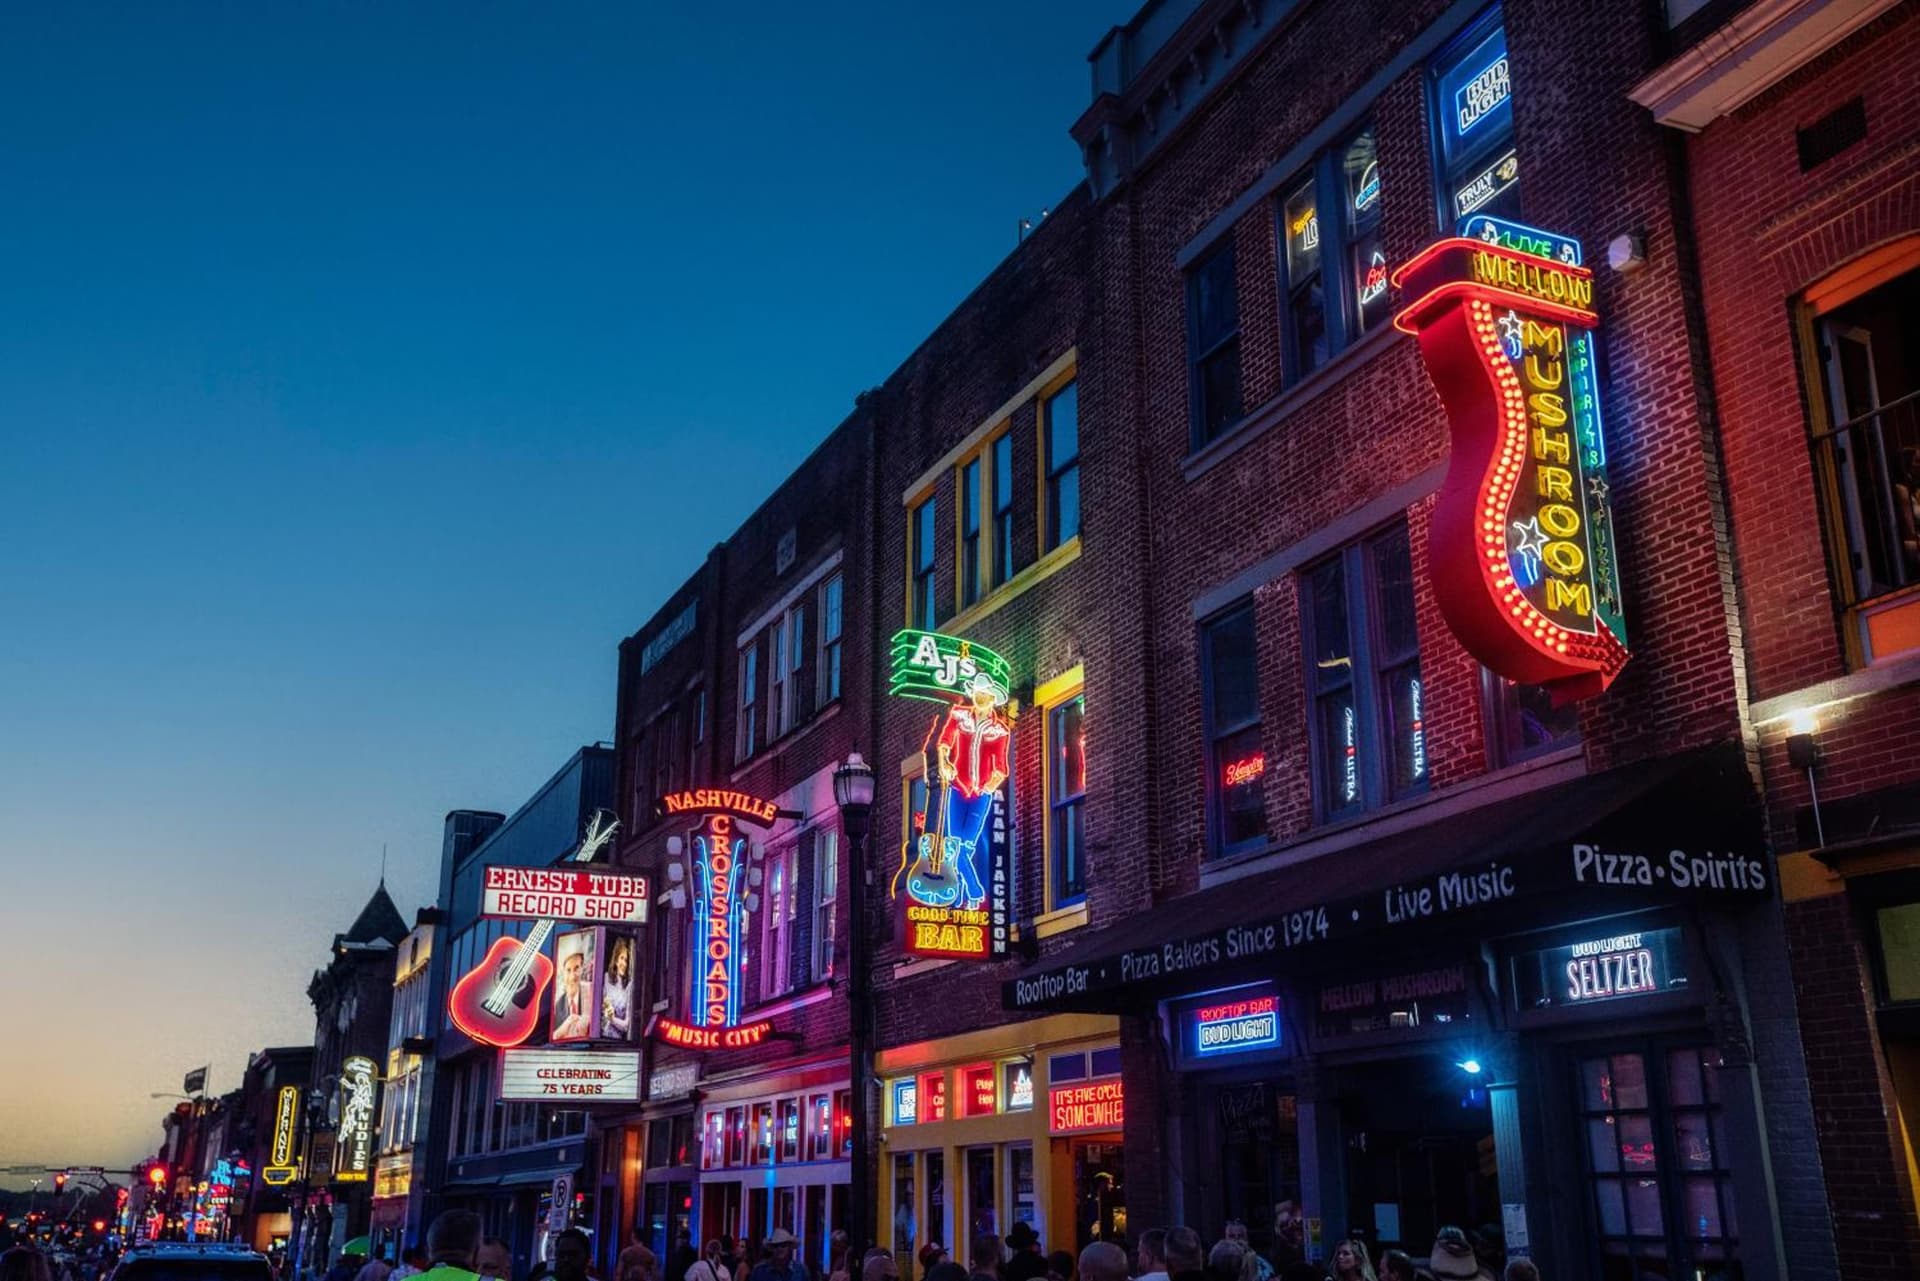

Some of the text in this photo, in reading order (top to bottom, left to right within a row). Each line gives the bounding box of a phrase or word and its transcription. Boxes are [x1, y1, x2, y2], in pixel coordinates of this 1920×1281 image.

[1466, 59, 1509, 104] BUD
[1459, 172, 1492, 205] TRULY
[1500, 231, 1552, 257] LIVE
[1476, 251, 1592, 305] MELLOW
[1575, 338, 1599, 466] SPIRITS
[1522, 320, 1593, 616] MUSHROOM
[1414, 731, 1424, 777] ULTRA
[1347, 756, 1356, 800] ULTRA
[664, 789, 777, 820] NASHVILLE
[487, 867, 646, 897] ERNEST TUBB
[993, 790, 1006, 953] ALAN JACKSON
[1573, 844, 1766, 890] Pizza Spirits
[498, 893, 635, 919] RECORD SHOP
[706, 815, 731, 1025] CROSSROADS
[915, 922, 984, 952] BAR
[1016, 862, 1515, 1006] Rooftop Bar Pizza Bakers Since 1974 Live Music
[1600, 933, 1642, 952] LIGHT
[1566, 949, 1656, 1000] SELTZER
[1201, 999, 1272, 1022] ROOFTOP BAR
[1202, 1017, 1272, 1045] BUD LIGHT
[536, 1068, 612, 1080] CELEBRATING
[542, 1084, 604, 1095] 75 YEARS
[1056, 1090, 1073, 1105] IT'S
[1075, 1087, 1096, 1103] FIVE
[1056, 1100, 1123, 1130] SOMEWHE
[352, 1111, 369, 1170] NUDIES
